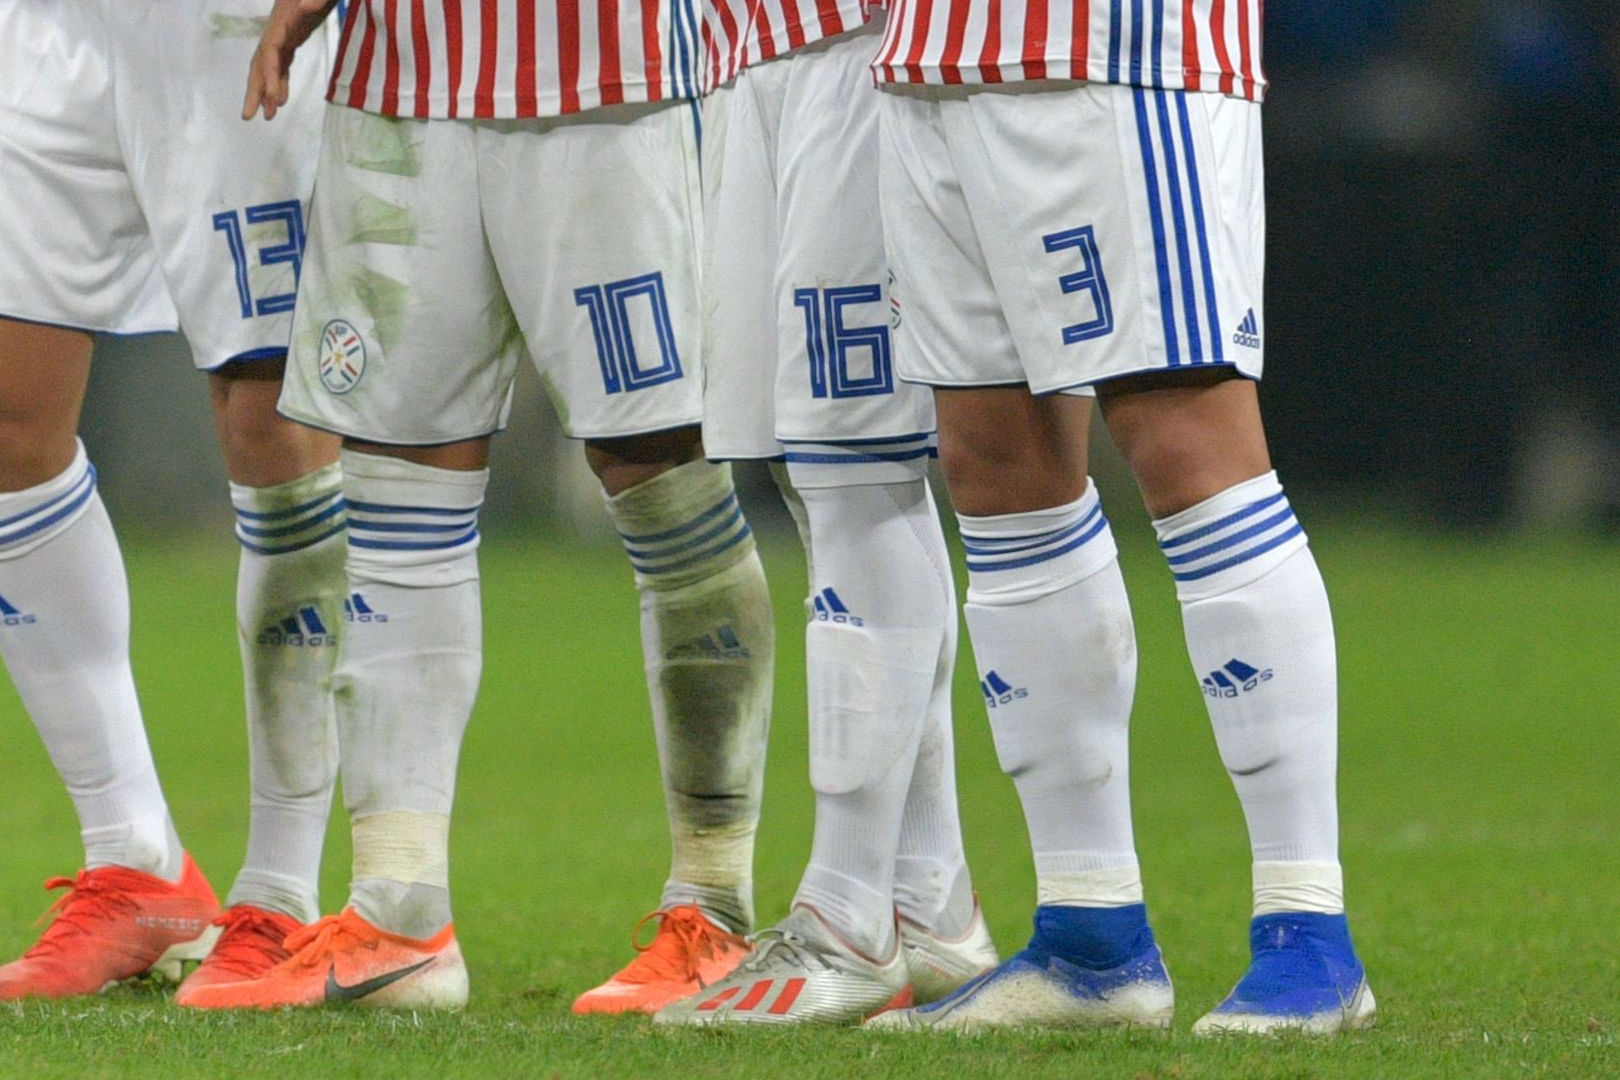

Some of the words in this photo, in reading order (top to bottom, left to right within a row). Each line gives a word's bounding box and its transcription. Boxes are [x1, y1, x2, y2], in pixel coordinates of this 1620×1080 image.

[212, 199, 308, 319] 13
[1042, 224, 1115, 346] 3
[573, 270, 684, 395] 10
[793, 284, 895, 400] 16
[1233, 332, 1260, 350] adidas
